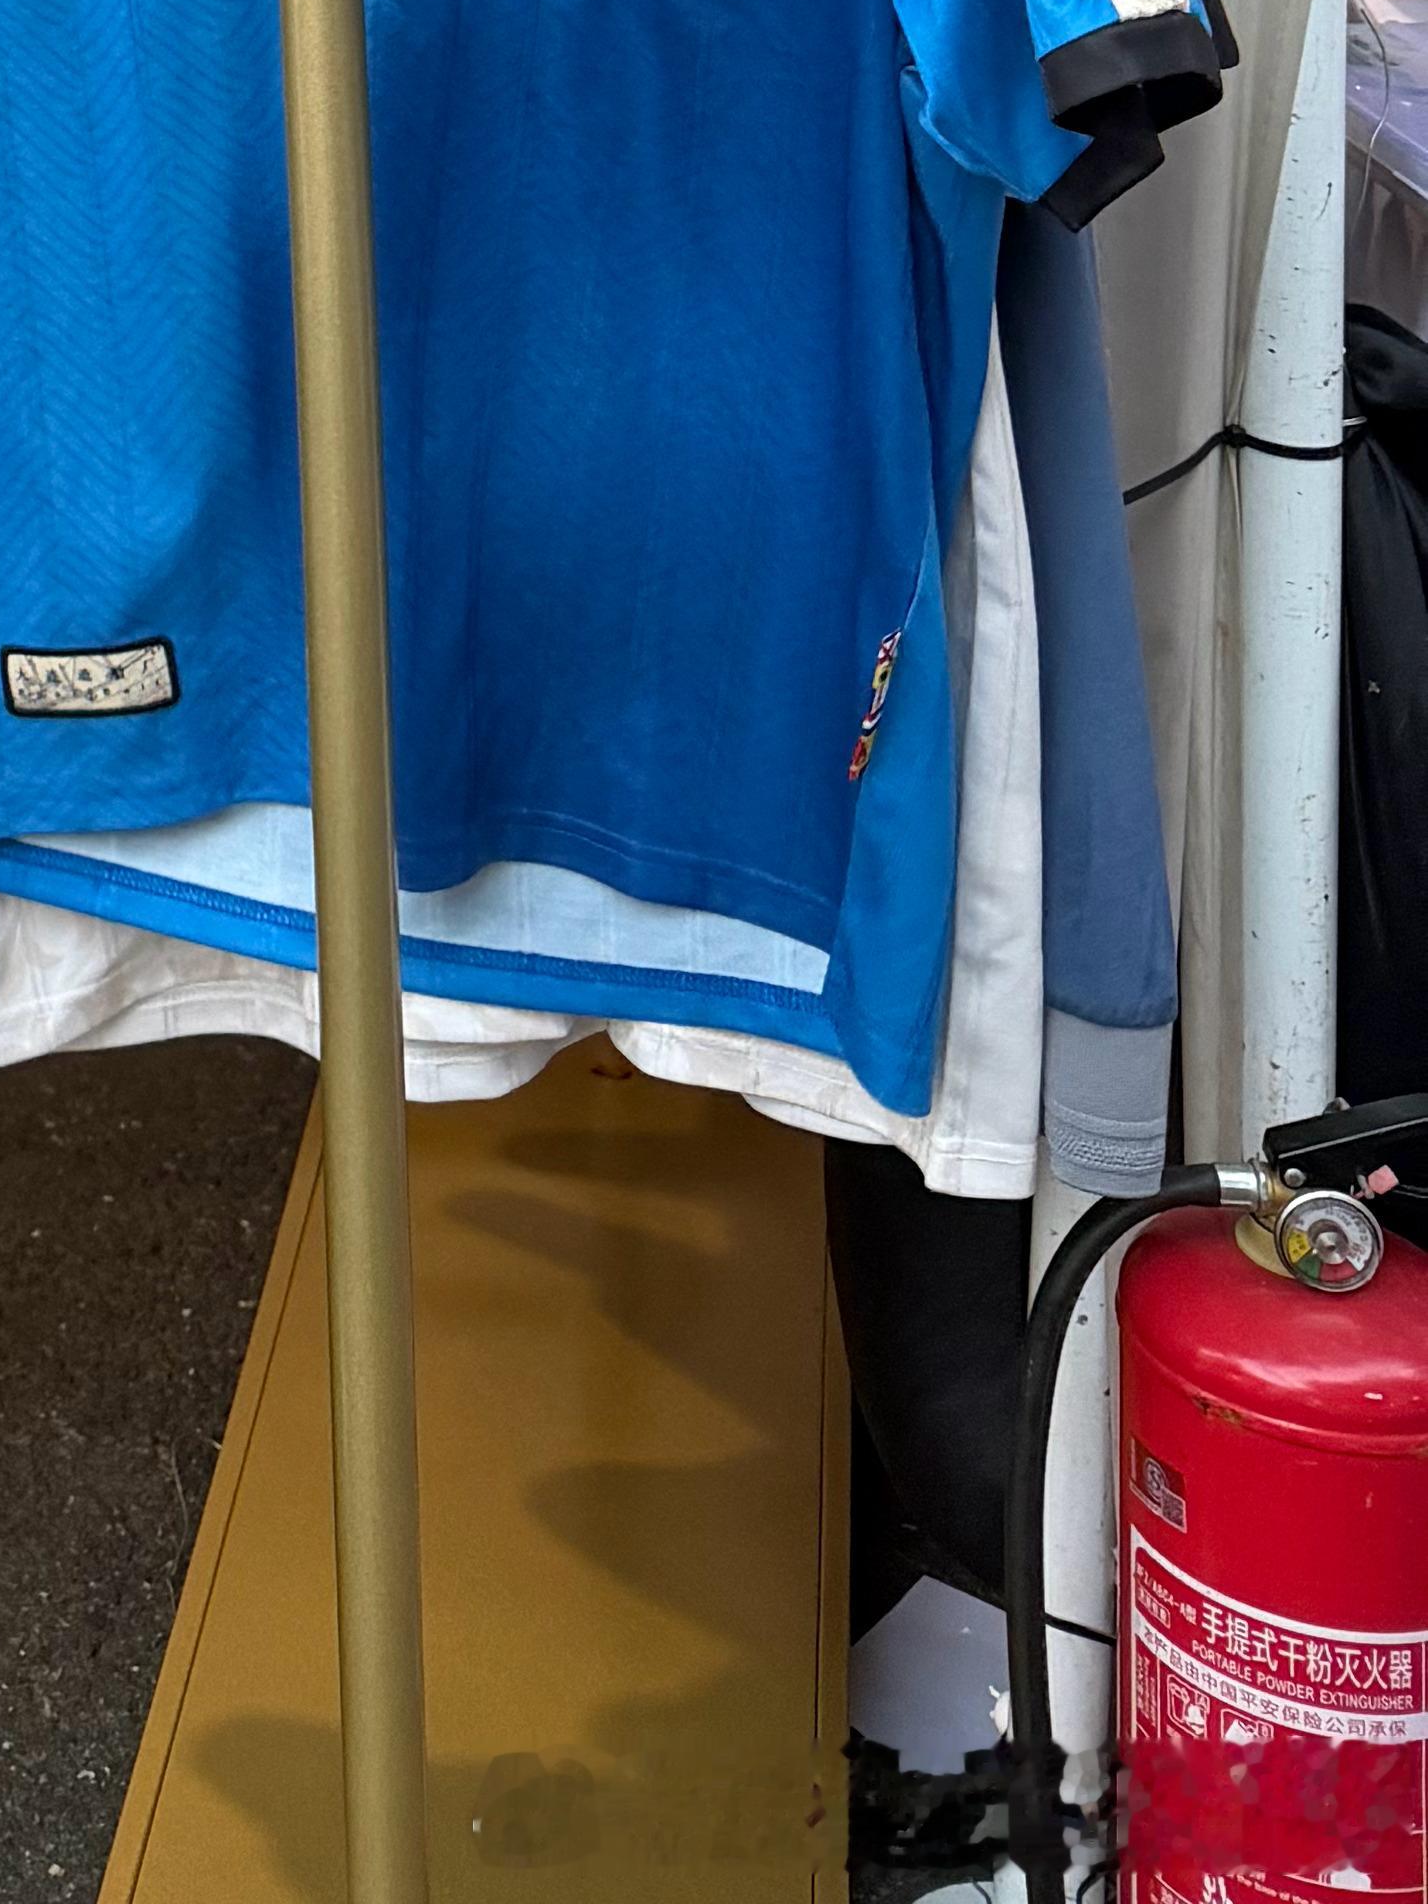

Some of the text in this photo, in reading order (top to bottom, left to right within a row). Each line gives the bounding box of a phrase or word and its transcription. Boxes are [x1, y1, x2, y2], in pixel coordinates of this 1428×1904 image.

[1192, 1639, 1414, 1711] PORTABLE POWDER EXTINGUISHER
[1201, 1601, 1413, 1691] 手提式干粉灭火器
